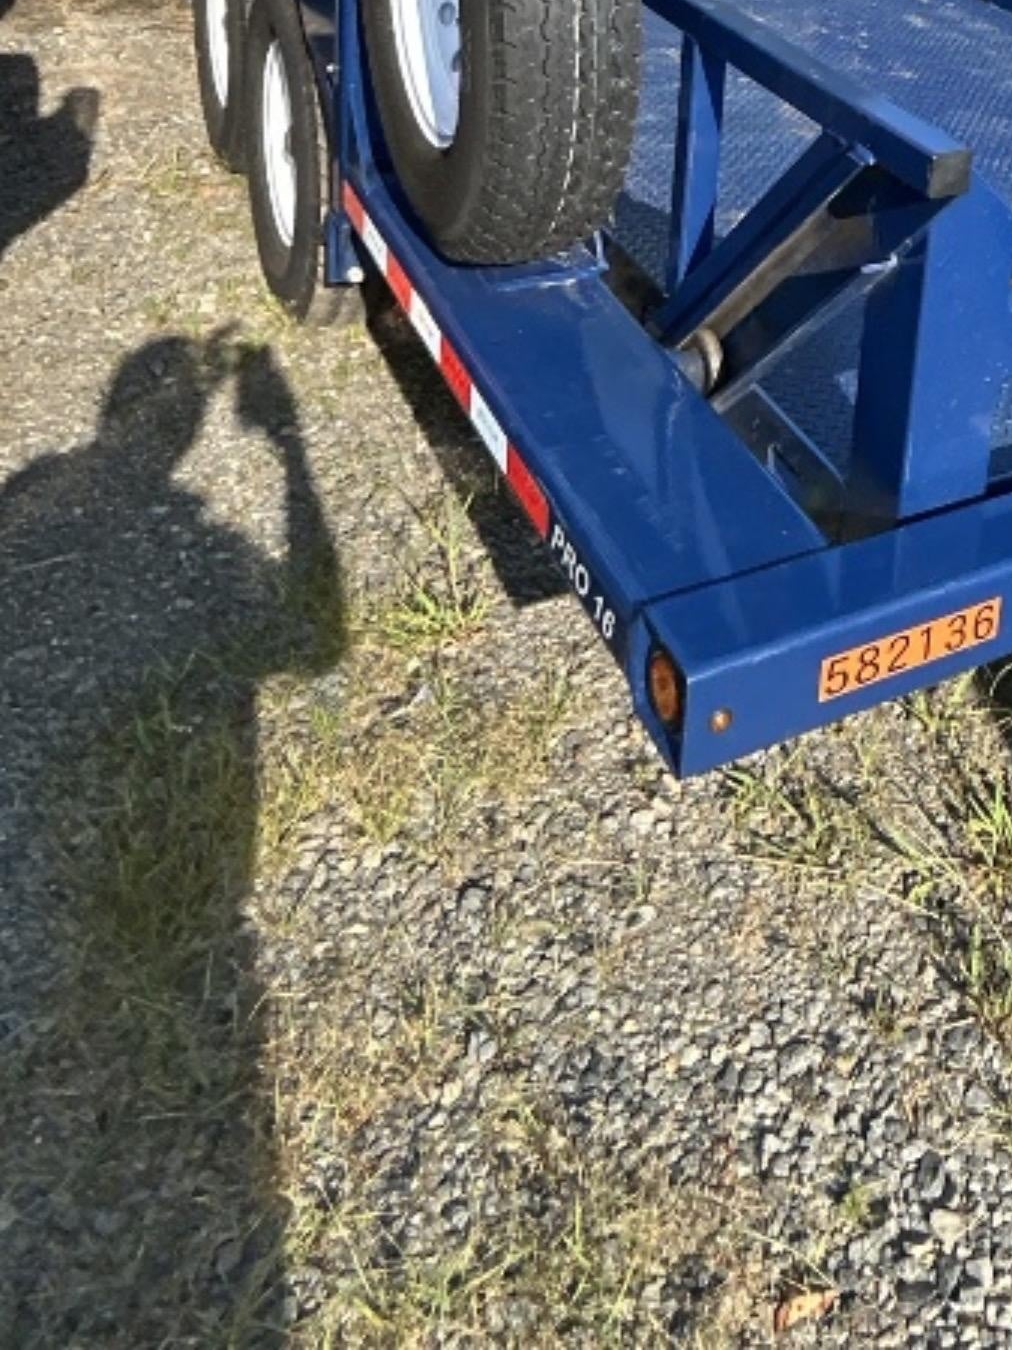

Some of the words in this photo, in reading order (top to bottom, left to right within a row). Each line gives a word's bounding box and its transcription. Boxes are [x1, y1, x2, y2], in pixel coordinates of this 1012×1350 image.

[551, 523, 590, 597] PRO
[593, 596, 617, 640] 16
[824, 605, 996, 696] 582136
